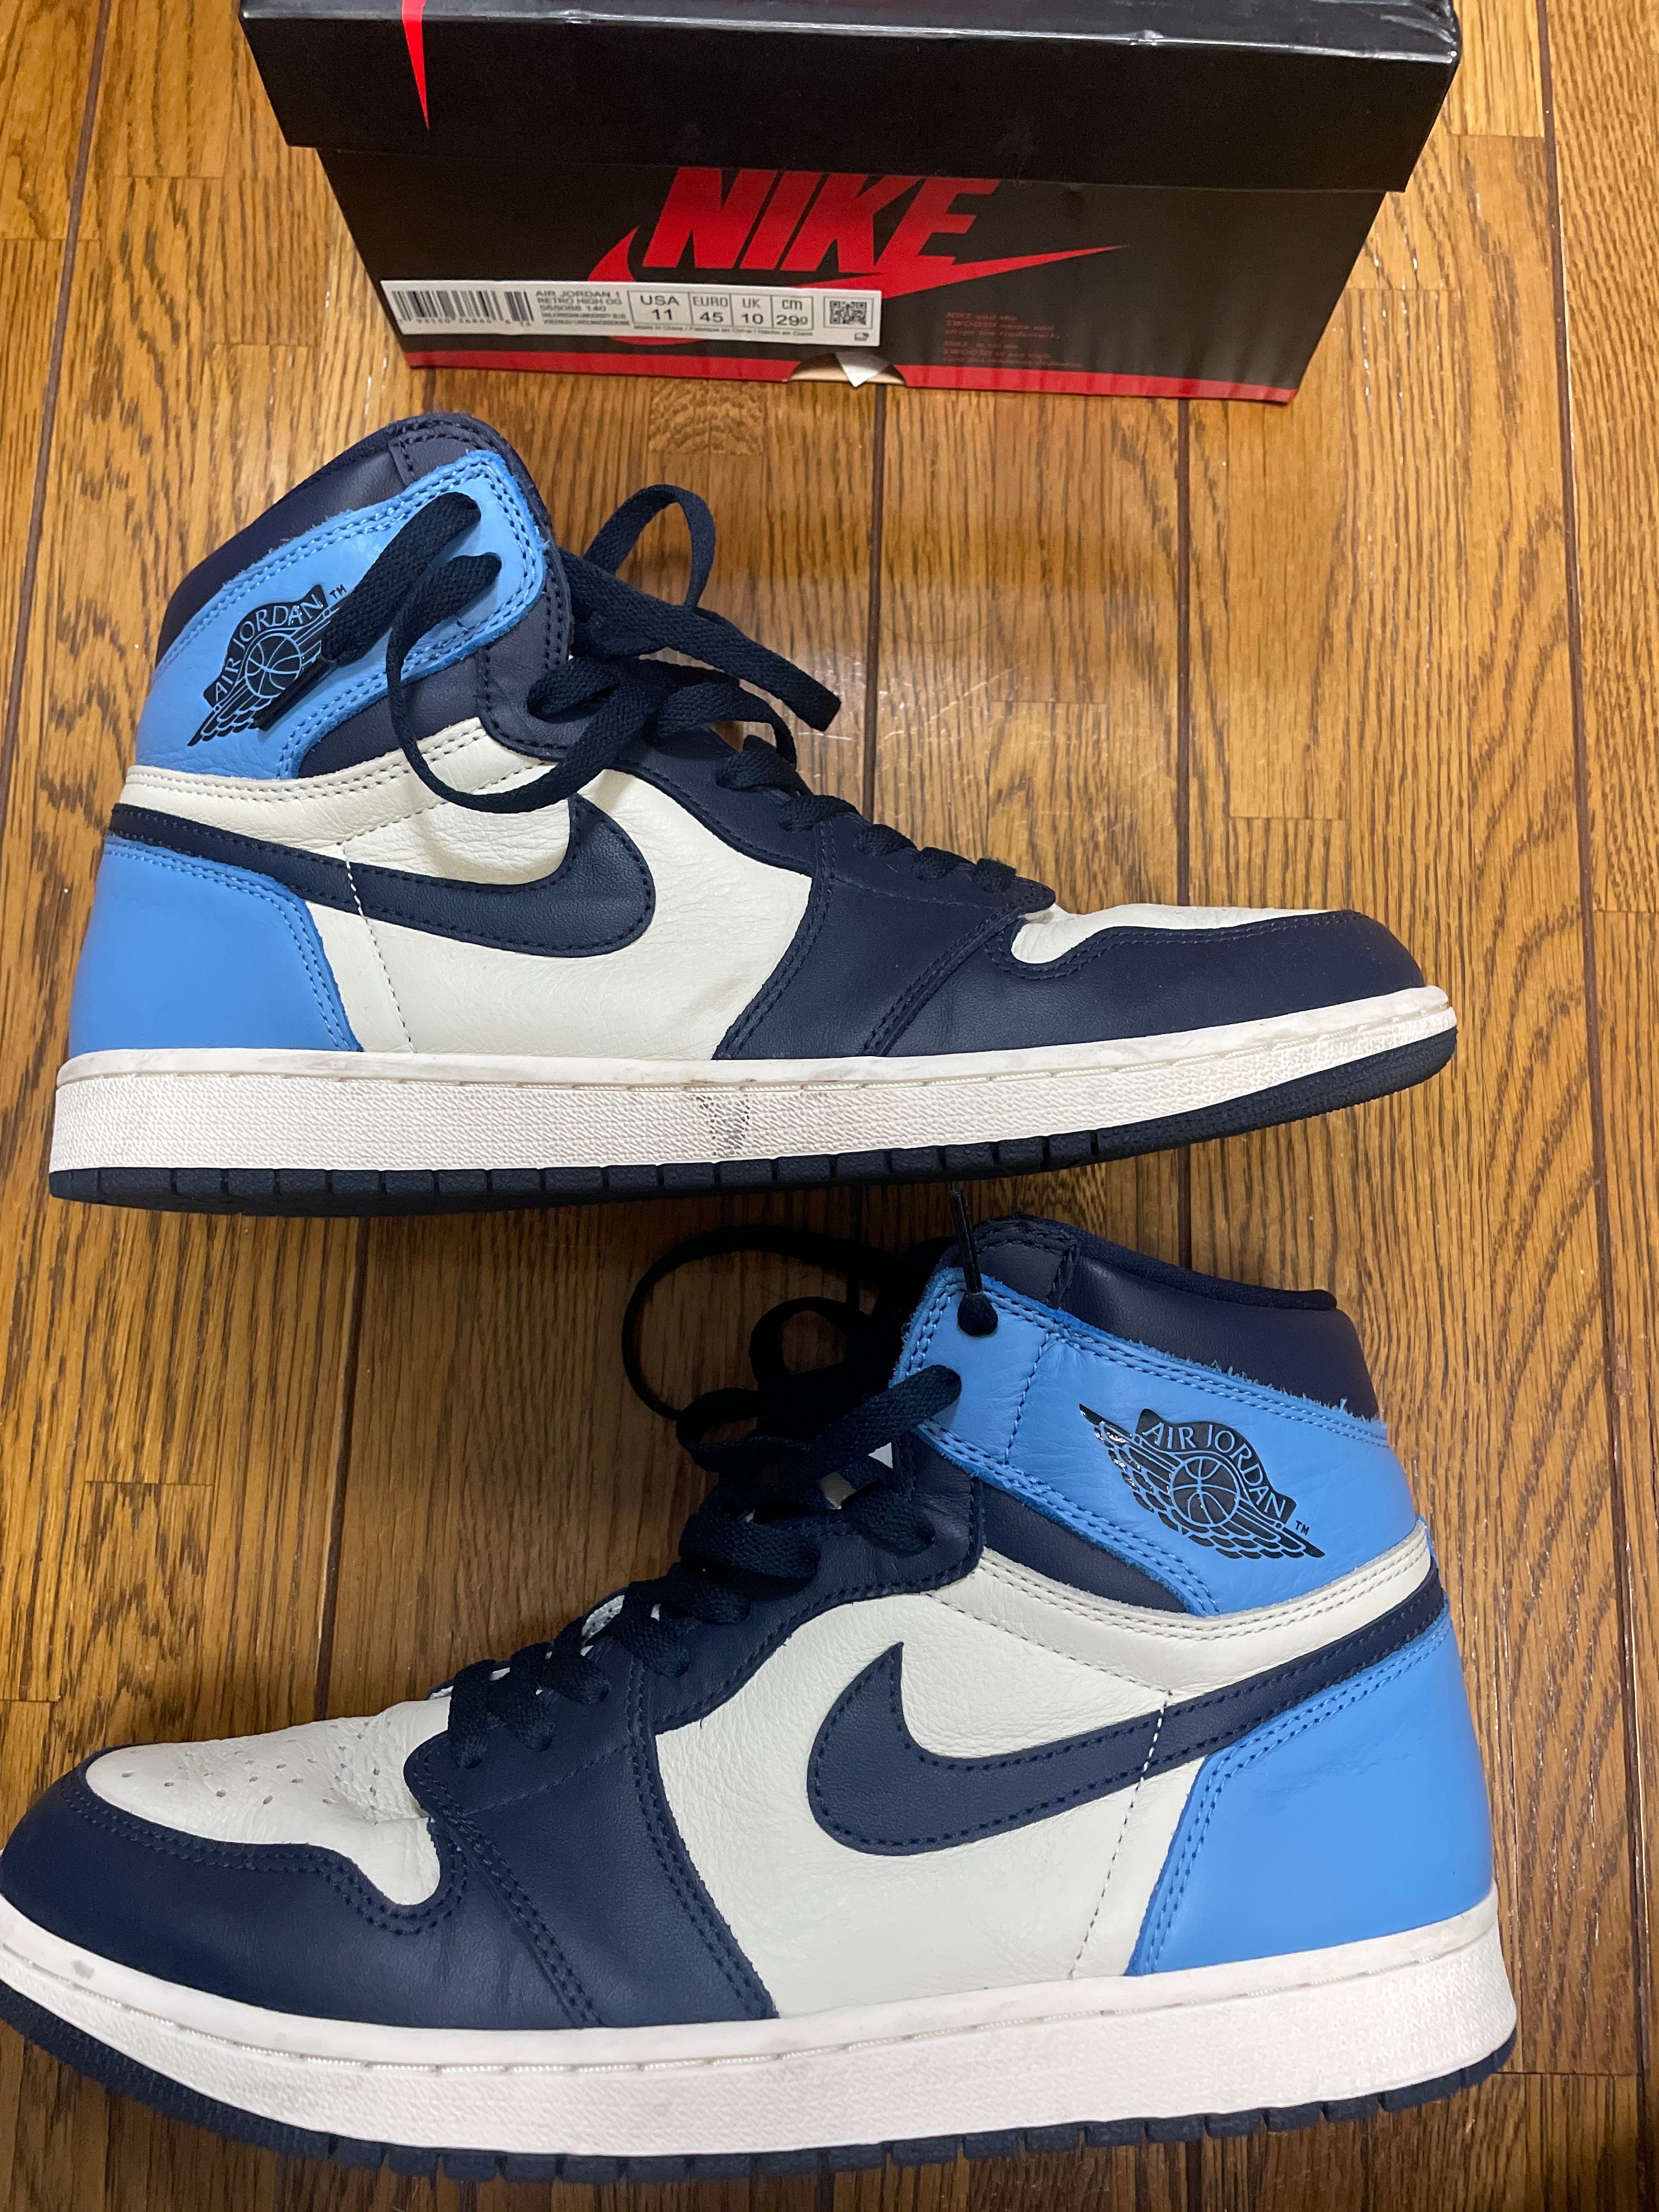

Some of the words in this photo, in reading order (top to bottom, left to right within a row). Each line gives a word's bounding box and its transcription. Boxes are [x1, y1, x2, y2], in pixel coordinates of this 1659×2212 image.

[643, 166, 1000, 274] NIKE
[640, 295, 680, 306] USA
[692, 296, 729, 307] EURO
[742, 298, 761, 309] UK
[651, 308, 673, 320] 11
[699, 311, 724, 323] 45
[741, 313, 764, 325] 10
[215, 657, 241, 702] AIR
[233, 594, 324, 652] JORDAN
[1142, 1421, 1197, 1450] AIR
[1206, 1424, 1286, 1518] JORDAN
